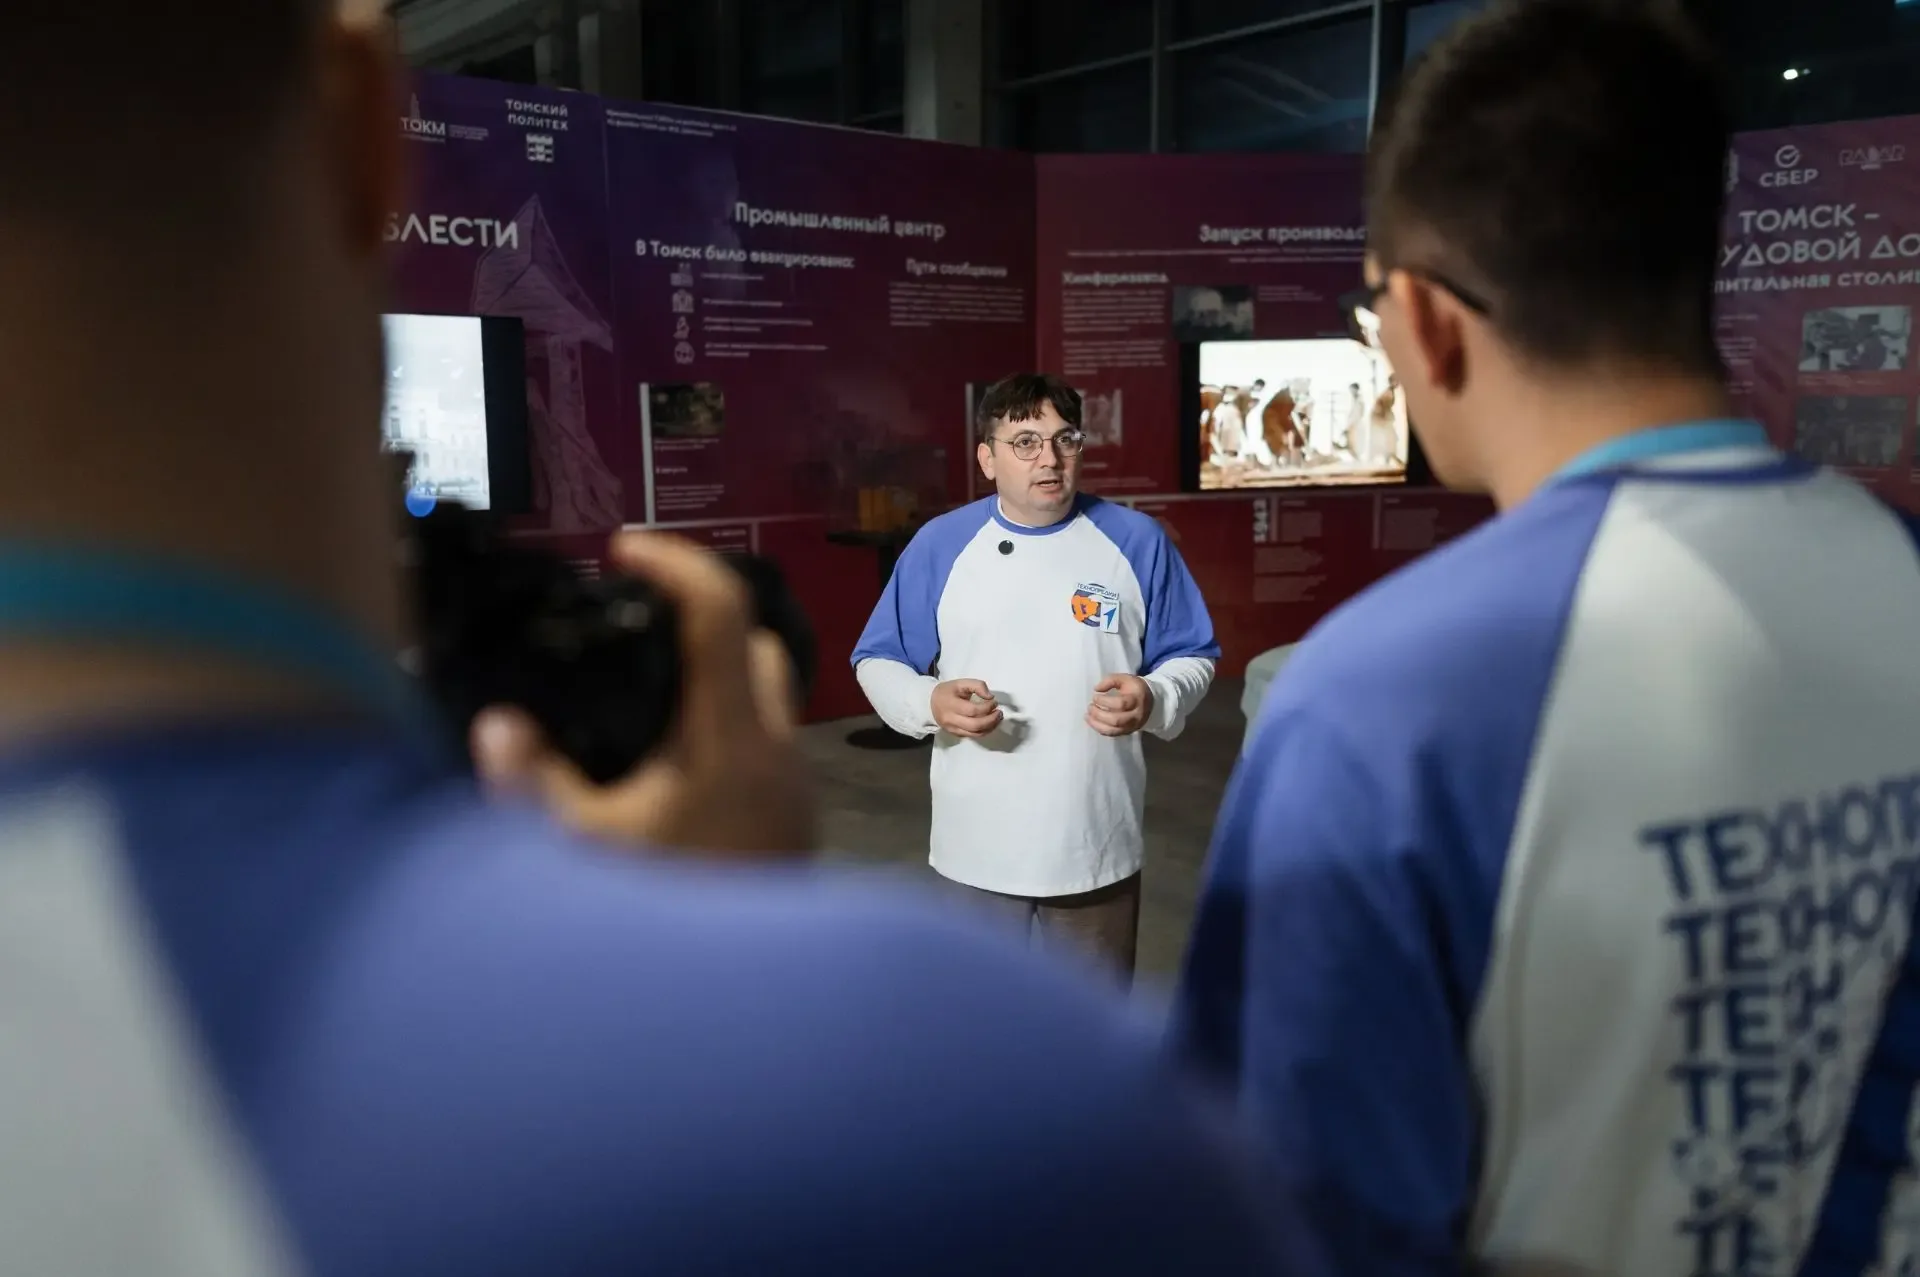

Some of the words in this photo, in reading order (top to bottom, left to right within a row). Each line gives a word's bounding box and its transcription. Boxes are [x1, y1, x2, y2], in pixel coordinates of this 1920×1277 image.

[505, 99, 569, 117] ТОМСКИЙ
[400, 117, 446, 136] ТОКМ
[507, 114, 569, 131] ПОЛИТЕХ
[1759, 168, 1819, 187] СБЕР
[735, 202, 890, 234] Промышленный
[894, 221, 946, 241] центр
[1738, 203, 1857, 234] ТОМСК
[382, 212, 519, 250] БЛЕСТИ
[1199, 225, 1263, 245] Запуск
[1267, 226, 1367, 245] производс
[635, 239, 646, 256] В
[649, 240, 701, 260] Томск
[705, 245, 747, 262] было
[1720, 231, 1861, 268] УДОВОЙ
[1870, 234, 1920, 259] ДО
[1713, 273, 1831, 294] питальная
[1640, 773, 1920, 902] ТЕХНОП
[1662, 857, 1917, 980] ТЕХНО
